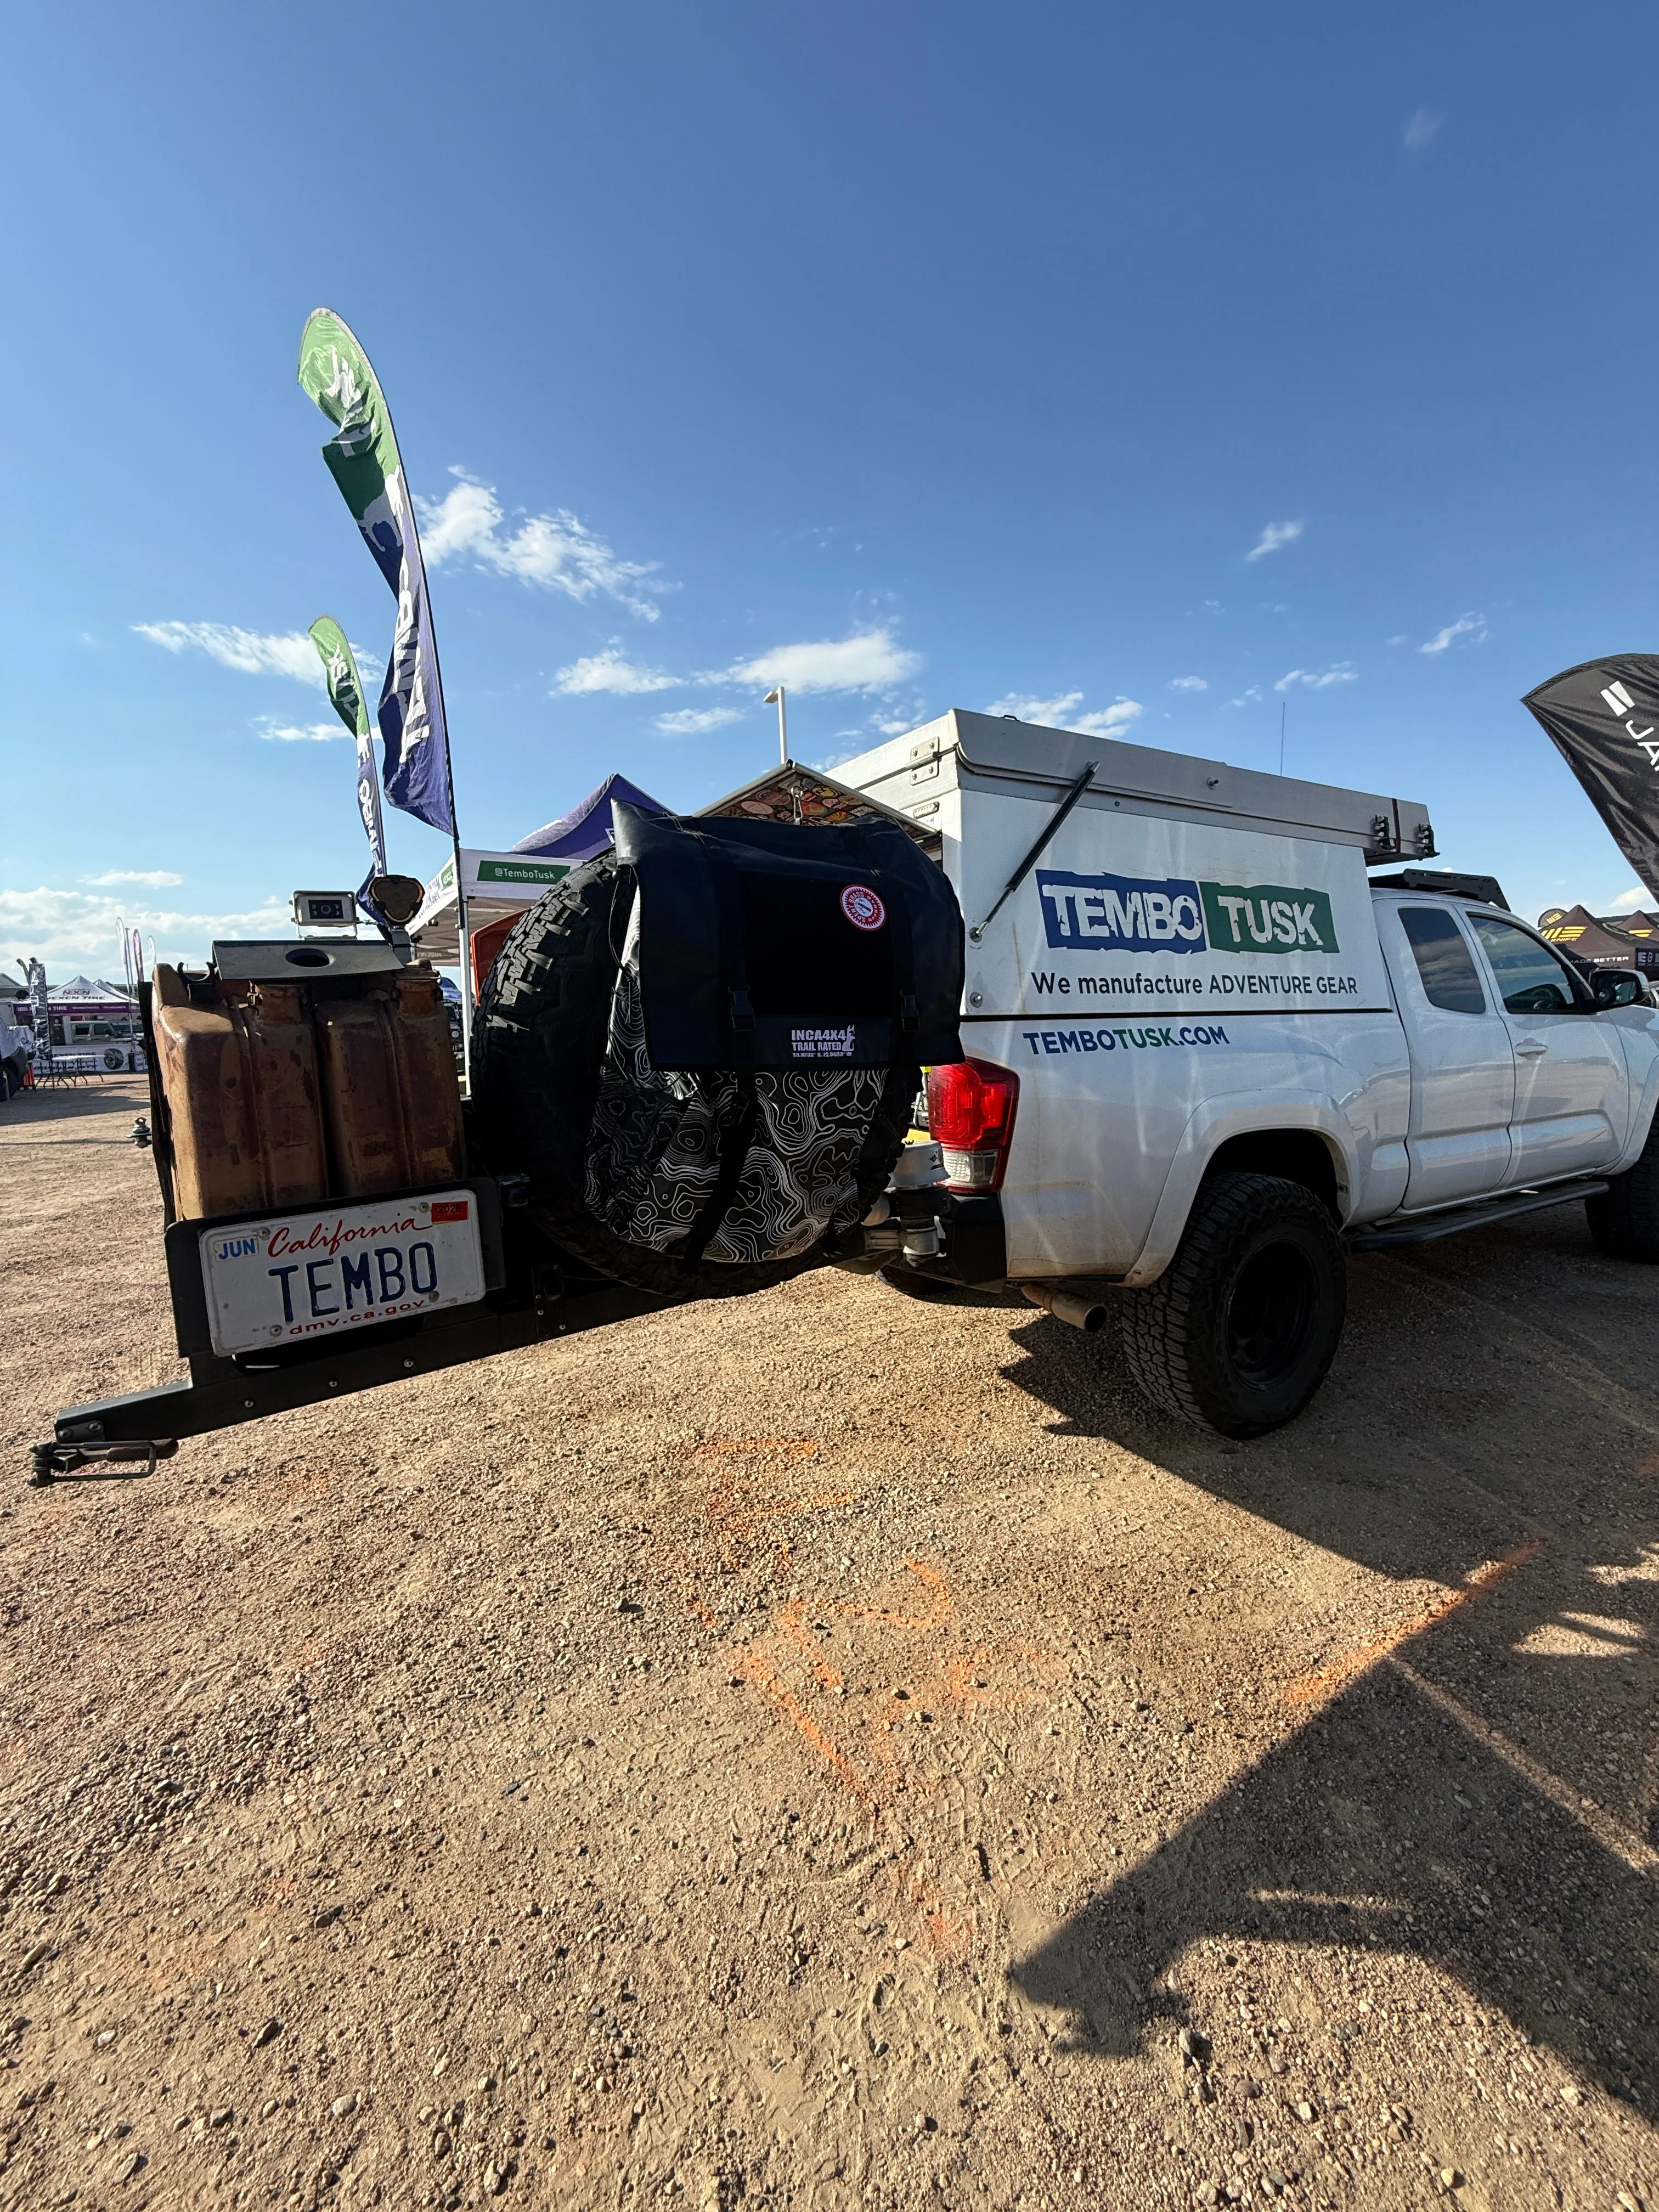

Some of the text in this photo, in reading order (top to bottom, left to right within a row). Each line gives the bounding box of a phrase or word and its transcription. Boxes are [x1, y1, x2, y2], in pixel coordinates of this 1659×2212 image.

[1626, 720, 1659, 771] JA
[495, 868, 555, 879] @TemboTusk
[1042, 884, 1323, 946] TEMBO TUSK
[1031, 972, 1358, 994] We manufacture ADVENTURE GEAR
[791, 1030, 846, 1041] INCA4X4
[792, 1042, 842, 1051] TRAIL RATED
[1023, 1026, 1230, 1054] TEMBOTUSK.COM
[218, 1238, 257, 1261] JUN
[268, 1213, 433, 1258] California
[268, 1242, 438, 1323] TEMBO
[289, 1299, 426, 1335] dmv.ca.gov
